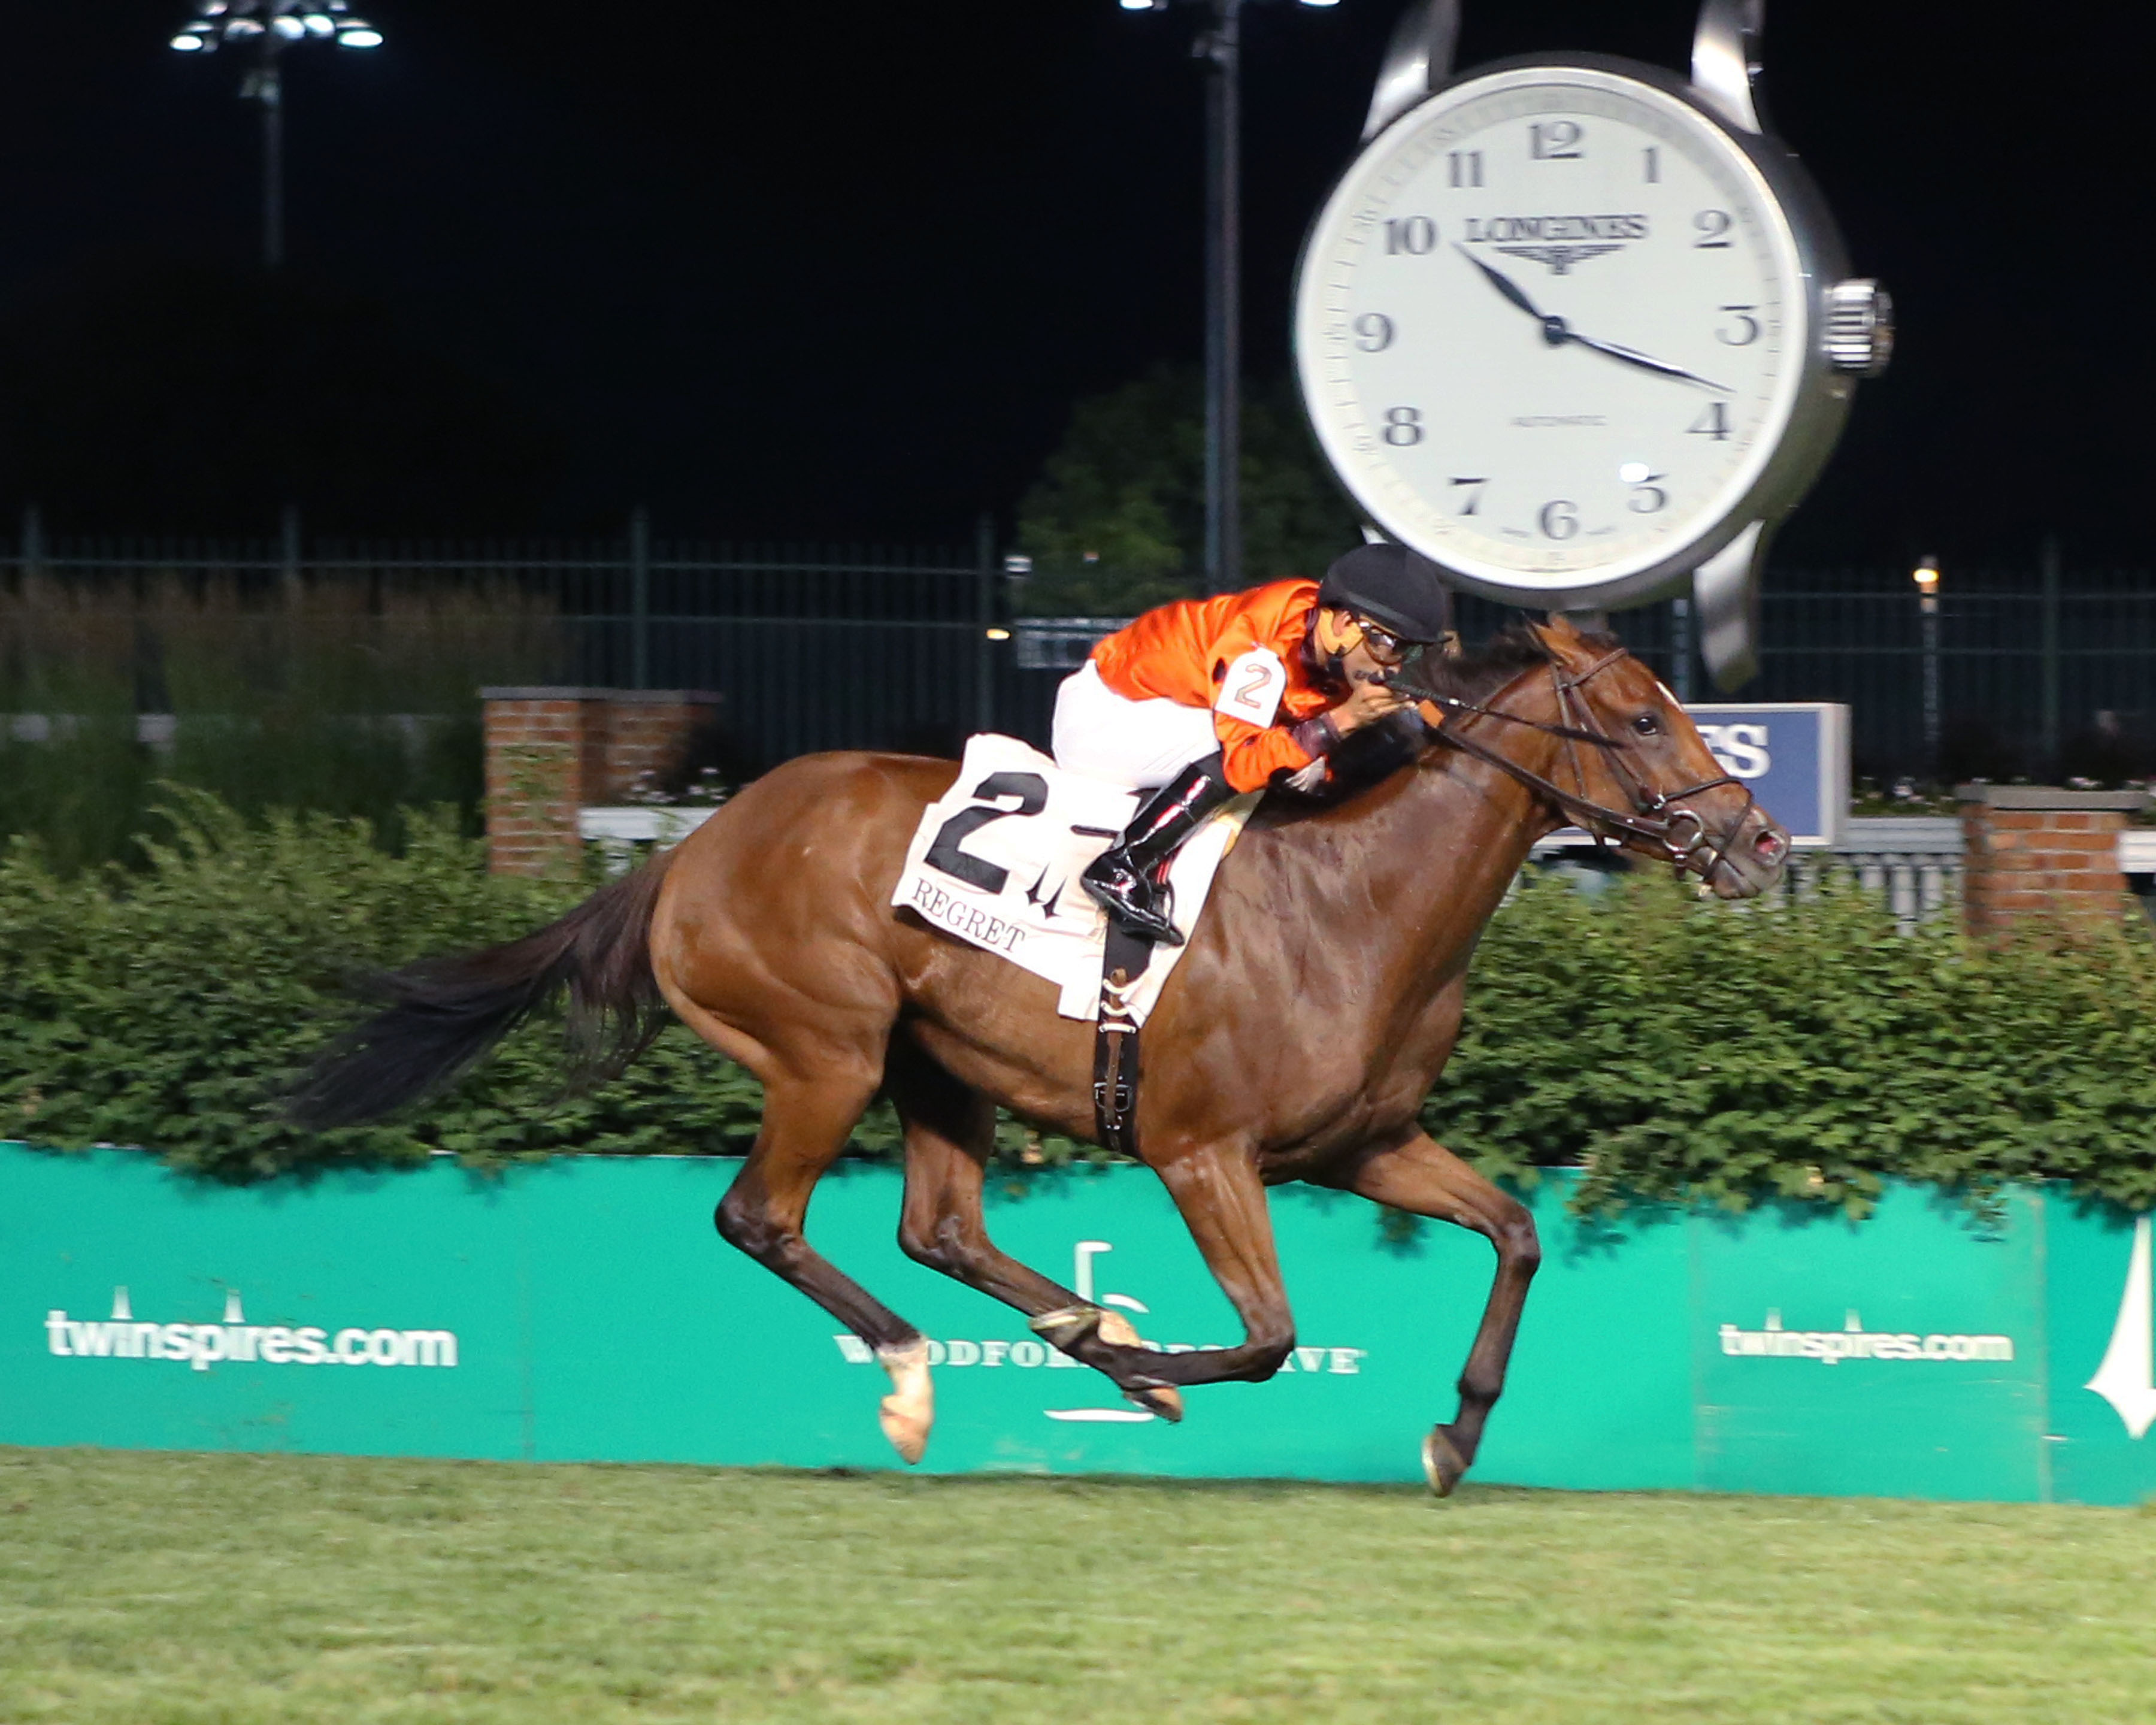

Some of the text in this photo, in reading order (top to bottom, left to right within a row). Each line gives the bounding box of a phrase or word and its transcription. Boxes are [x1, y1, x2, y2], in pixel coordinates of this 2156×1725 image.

[1528, 120, 1582, 160] 12
[1446, 150, 1486, 187] 11
[1642, 146, 1661, 183] 1
[1383, 216, 1438, 255] 10
[1464, 213, 1649, 242] LONGINES
[1693, 209, 1732, 249] 2
[1353, 312, 1396, 352] 9
[1714, 304, 1759, 346] 3
[1380, 406, 1423, 446] 8
[1684, 401, 1733, 440] 4
[1448, 477, 1490, 515] 7
[1627, 473, 1669, 513] 5
[1538, 499, 1579, 540] 6
[1234, 664, 1272, 710] 2
[923, 771, 1049, 895] 2
[911, 877, 1025, 953] REGRET
[45, 1287, 458, 1372] twinspires.com
[1719, 1308, 2015, 1365] twinspires.com
